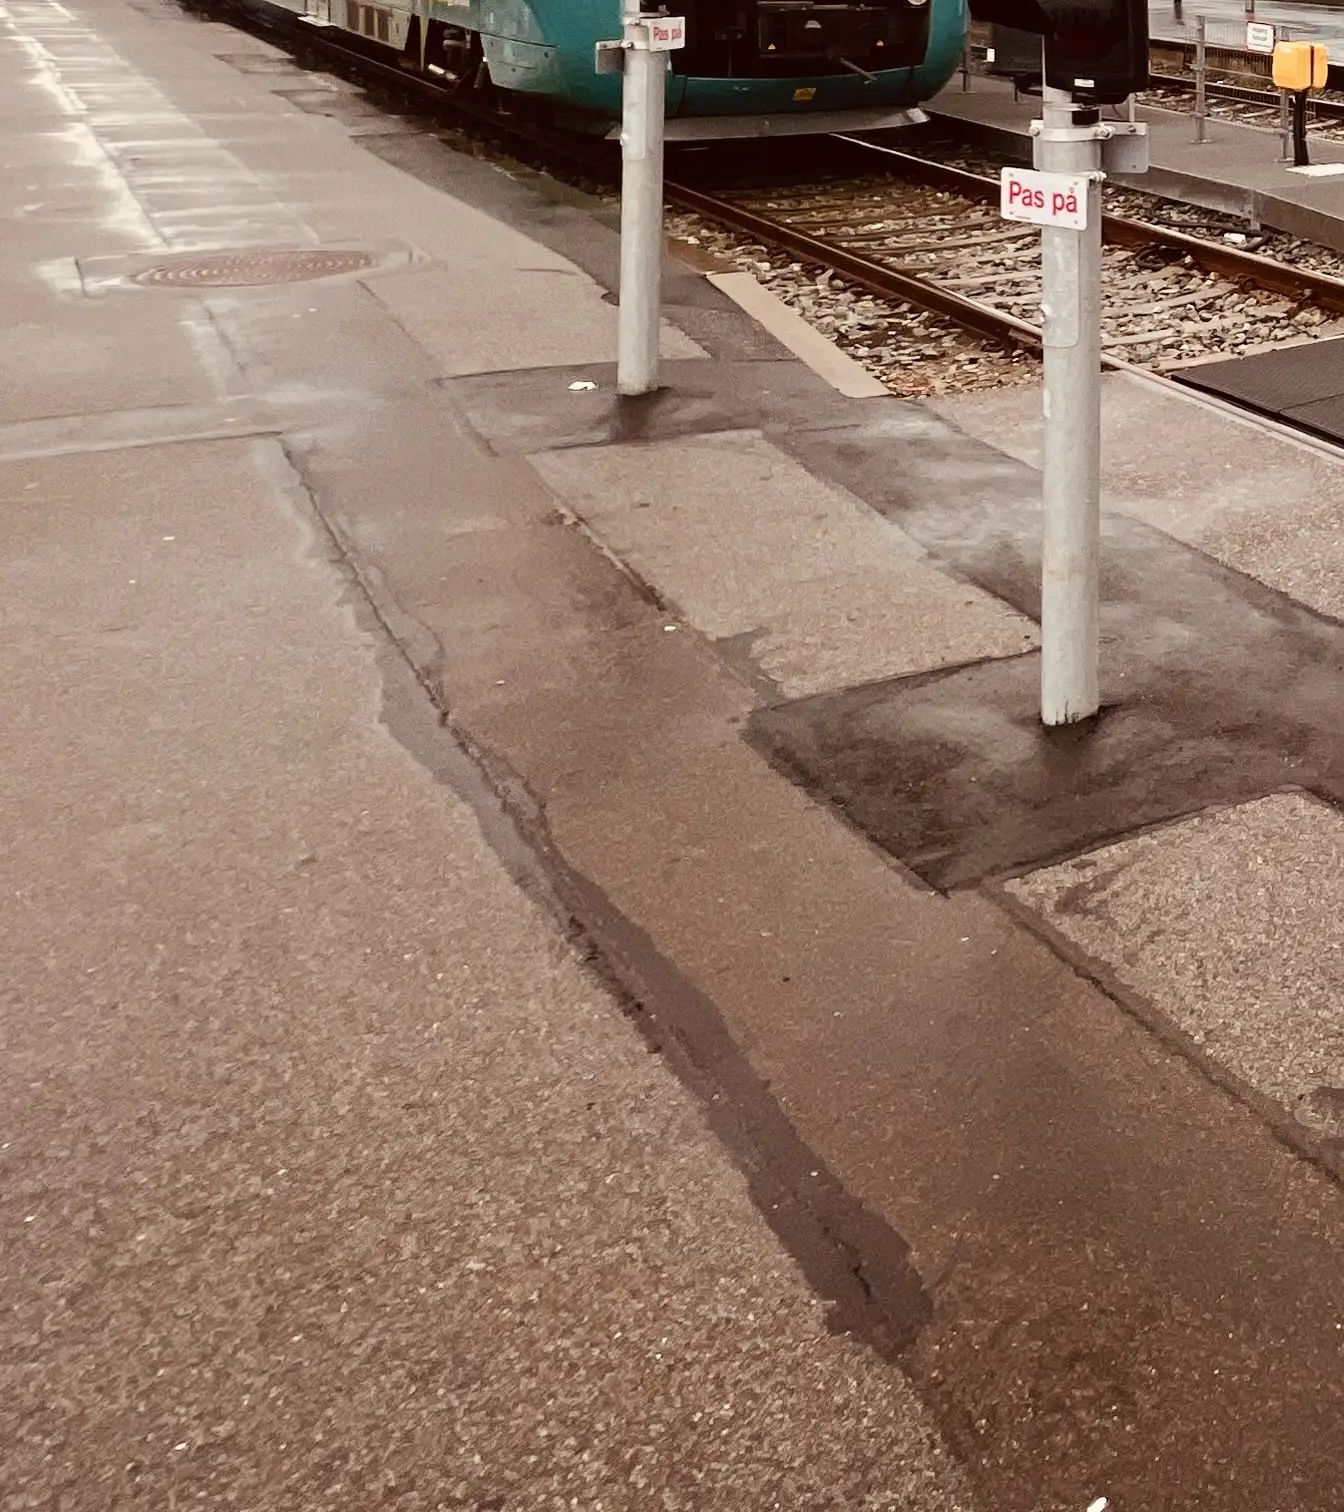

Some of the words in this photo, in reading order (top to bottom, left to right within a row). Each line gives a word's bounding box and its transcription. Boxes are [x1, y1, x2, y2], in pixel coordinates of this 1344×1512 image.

[653, 26, 669, 41] Pas
[671, 24, 682, 42] på
[1009, 180, 1044, 209] Pas
[1053, 186, 1077, 216] på
